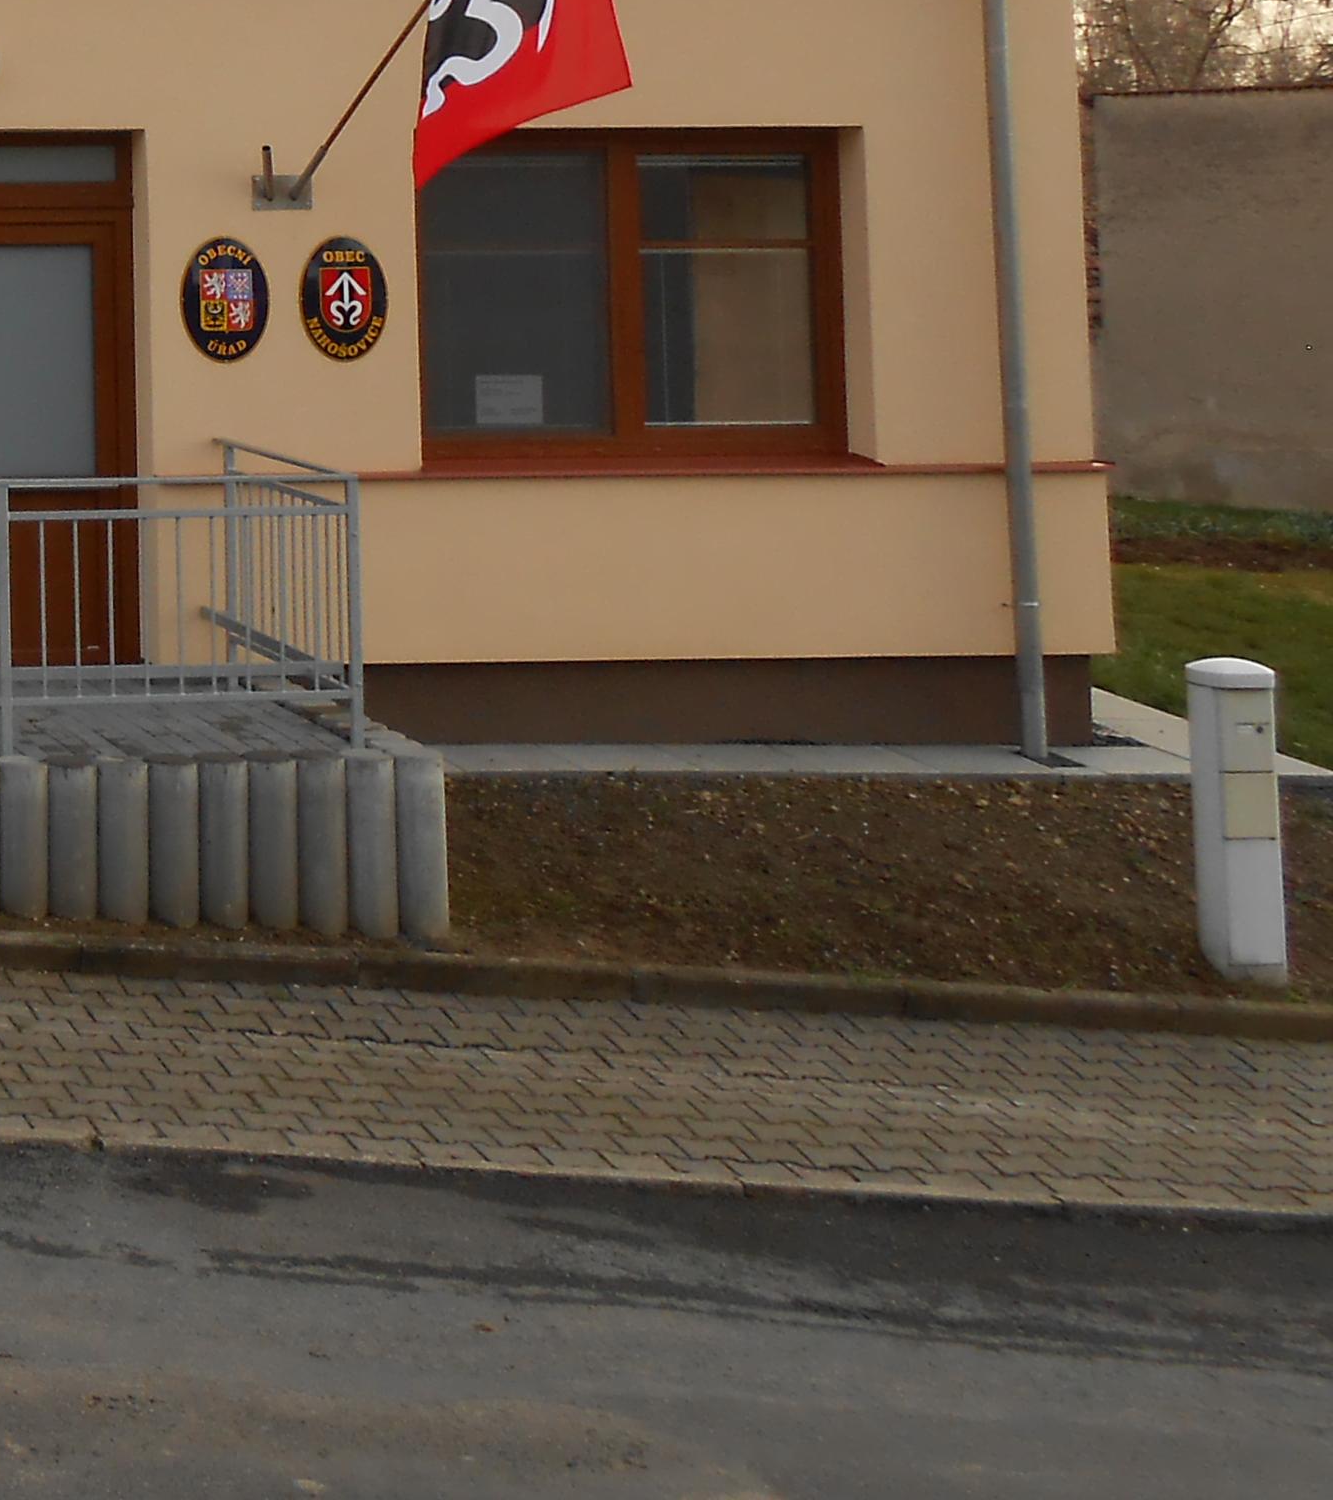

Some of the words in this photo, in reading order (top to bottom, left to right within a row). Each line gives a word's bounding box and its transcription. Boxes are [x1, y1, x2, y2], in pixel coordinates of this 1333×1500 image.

[198, 244, 253, 266] OBECNÍ
[322, 250, 366, 263] OBEC
[307, 315, 384, 357] NAHOŠOVICE
[207, 339, 247, 356] ÚŘAD
